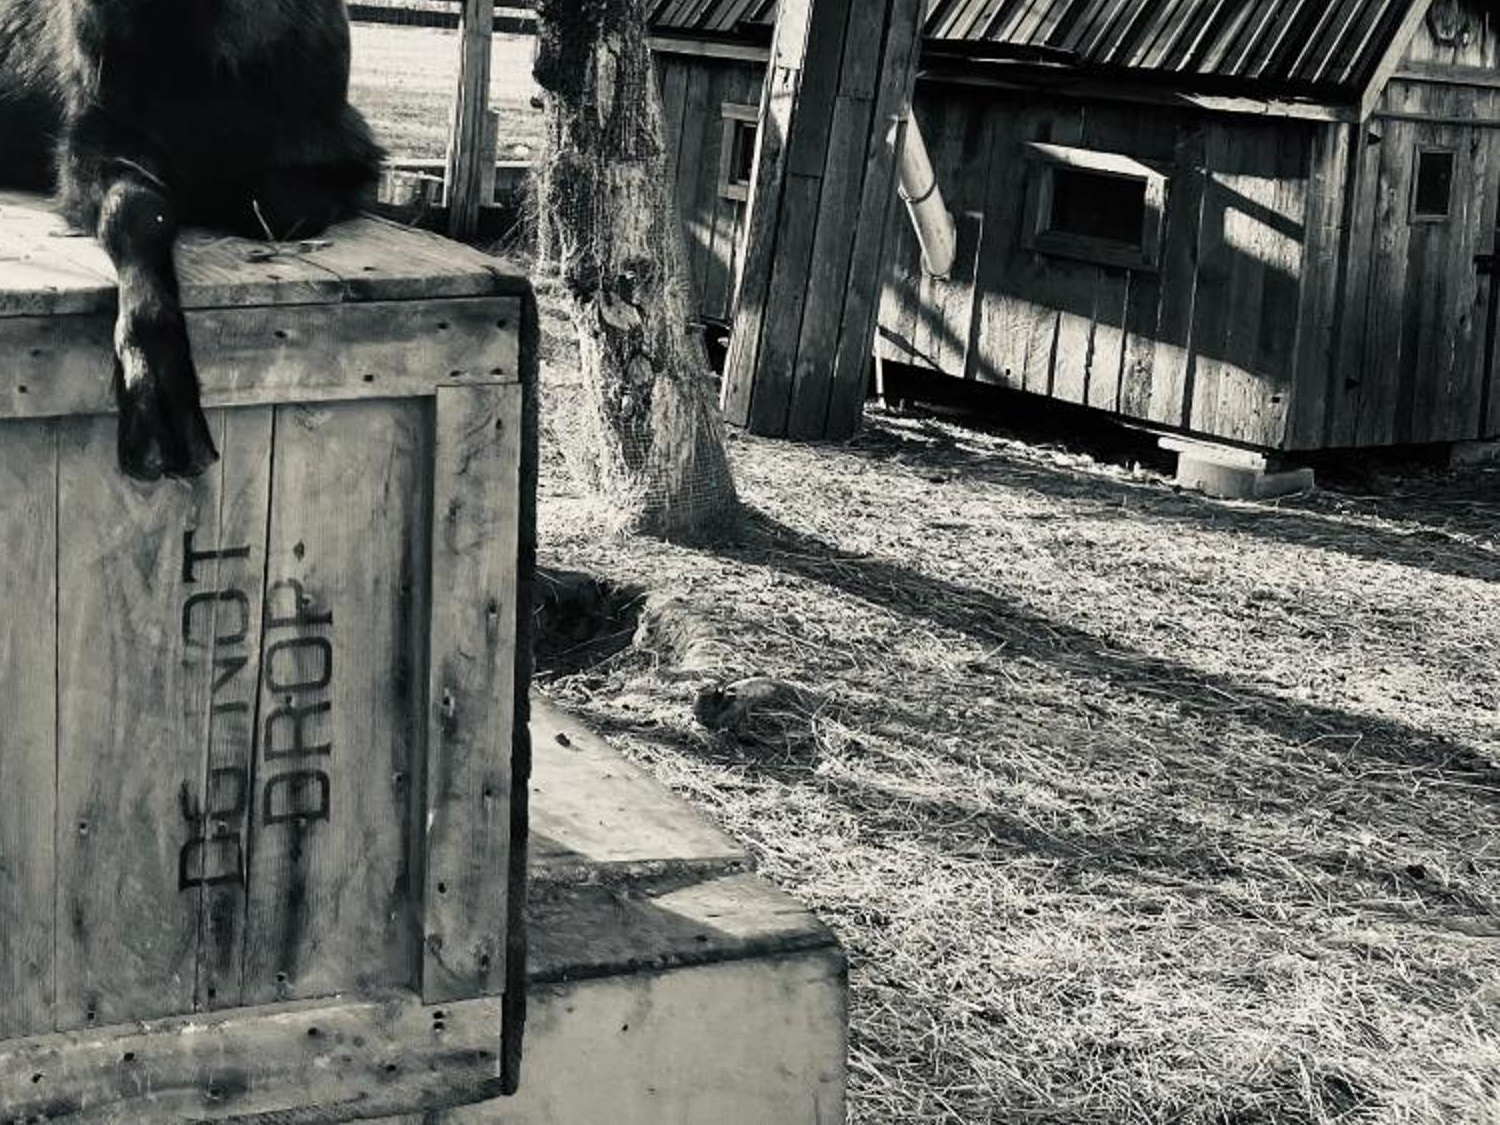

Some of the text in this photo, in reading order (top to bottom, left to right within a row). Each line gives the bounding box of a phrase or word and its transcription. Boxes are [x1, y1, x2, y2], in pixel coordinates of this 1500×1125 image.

[178, 530, 250, 892] DO NOT
[263, 578, 333, 826] DROP
